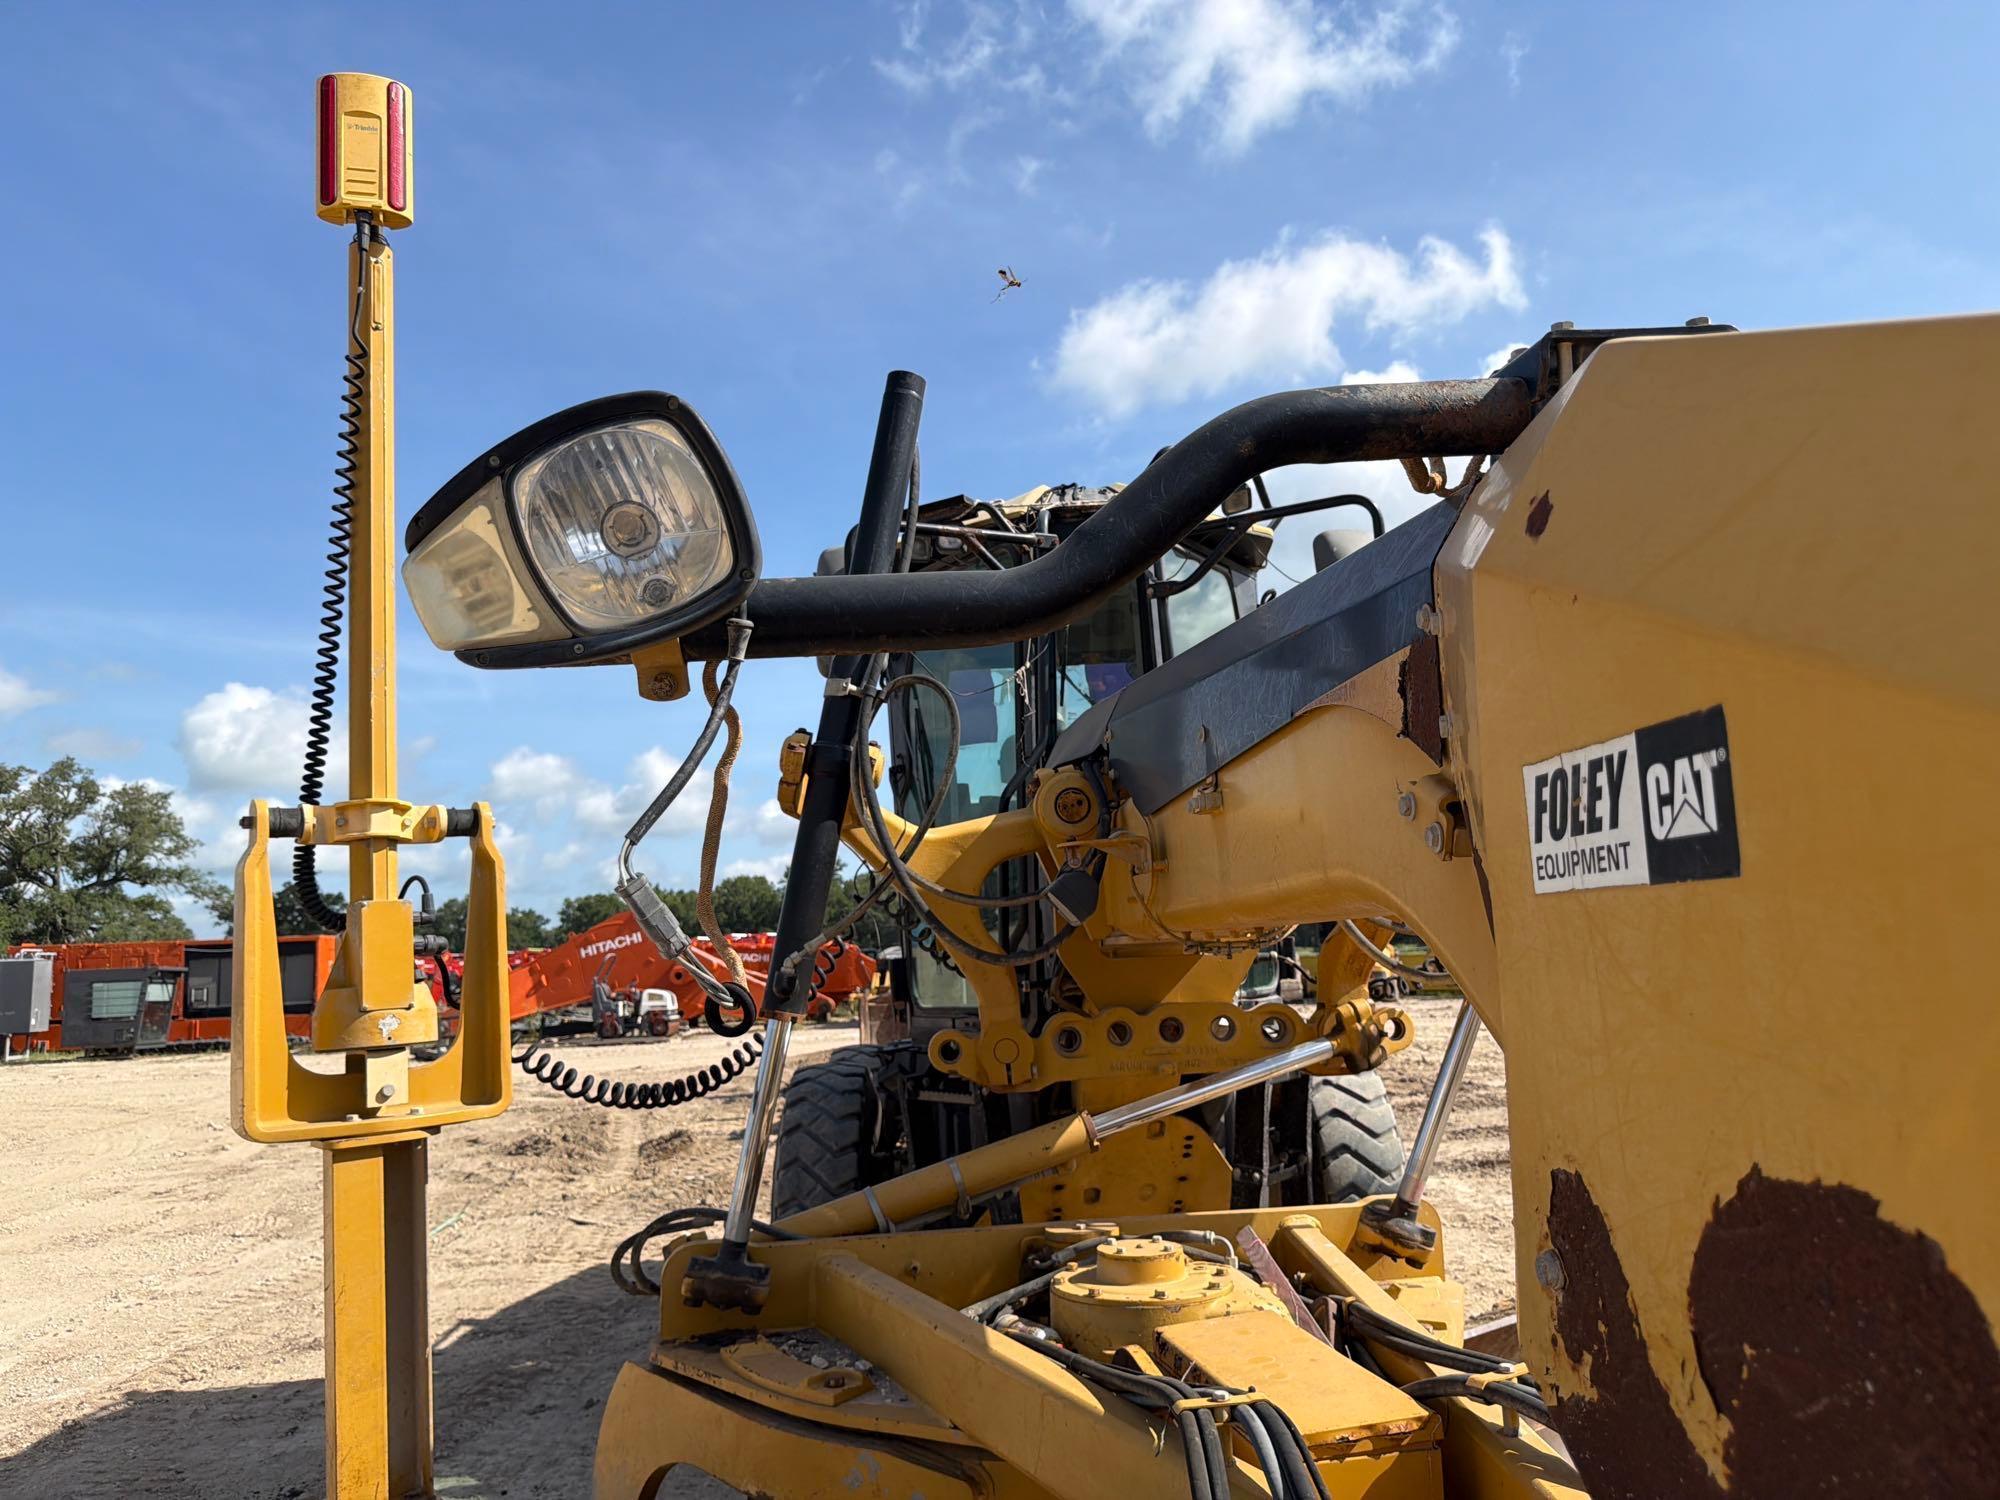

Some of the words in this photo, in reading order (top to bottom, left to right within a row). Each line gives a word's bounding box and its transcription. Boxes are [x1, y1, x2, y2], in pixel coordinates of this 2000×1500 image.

[1534, 749, 1628, 844] FOLEY
[1536, 841, 1630, 881] EQUIPMENT
[580, 931, 643, 959] HITACHI
